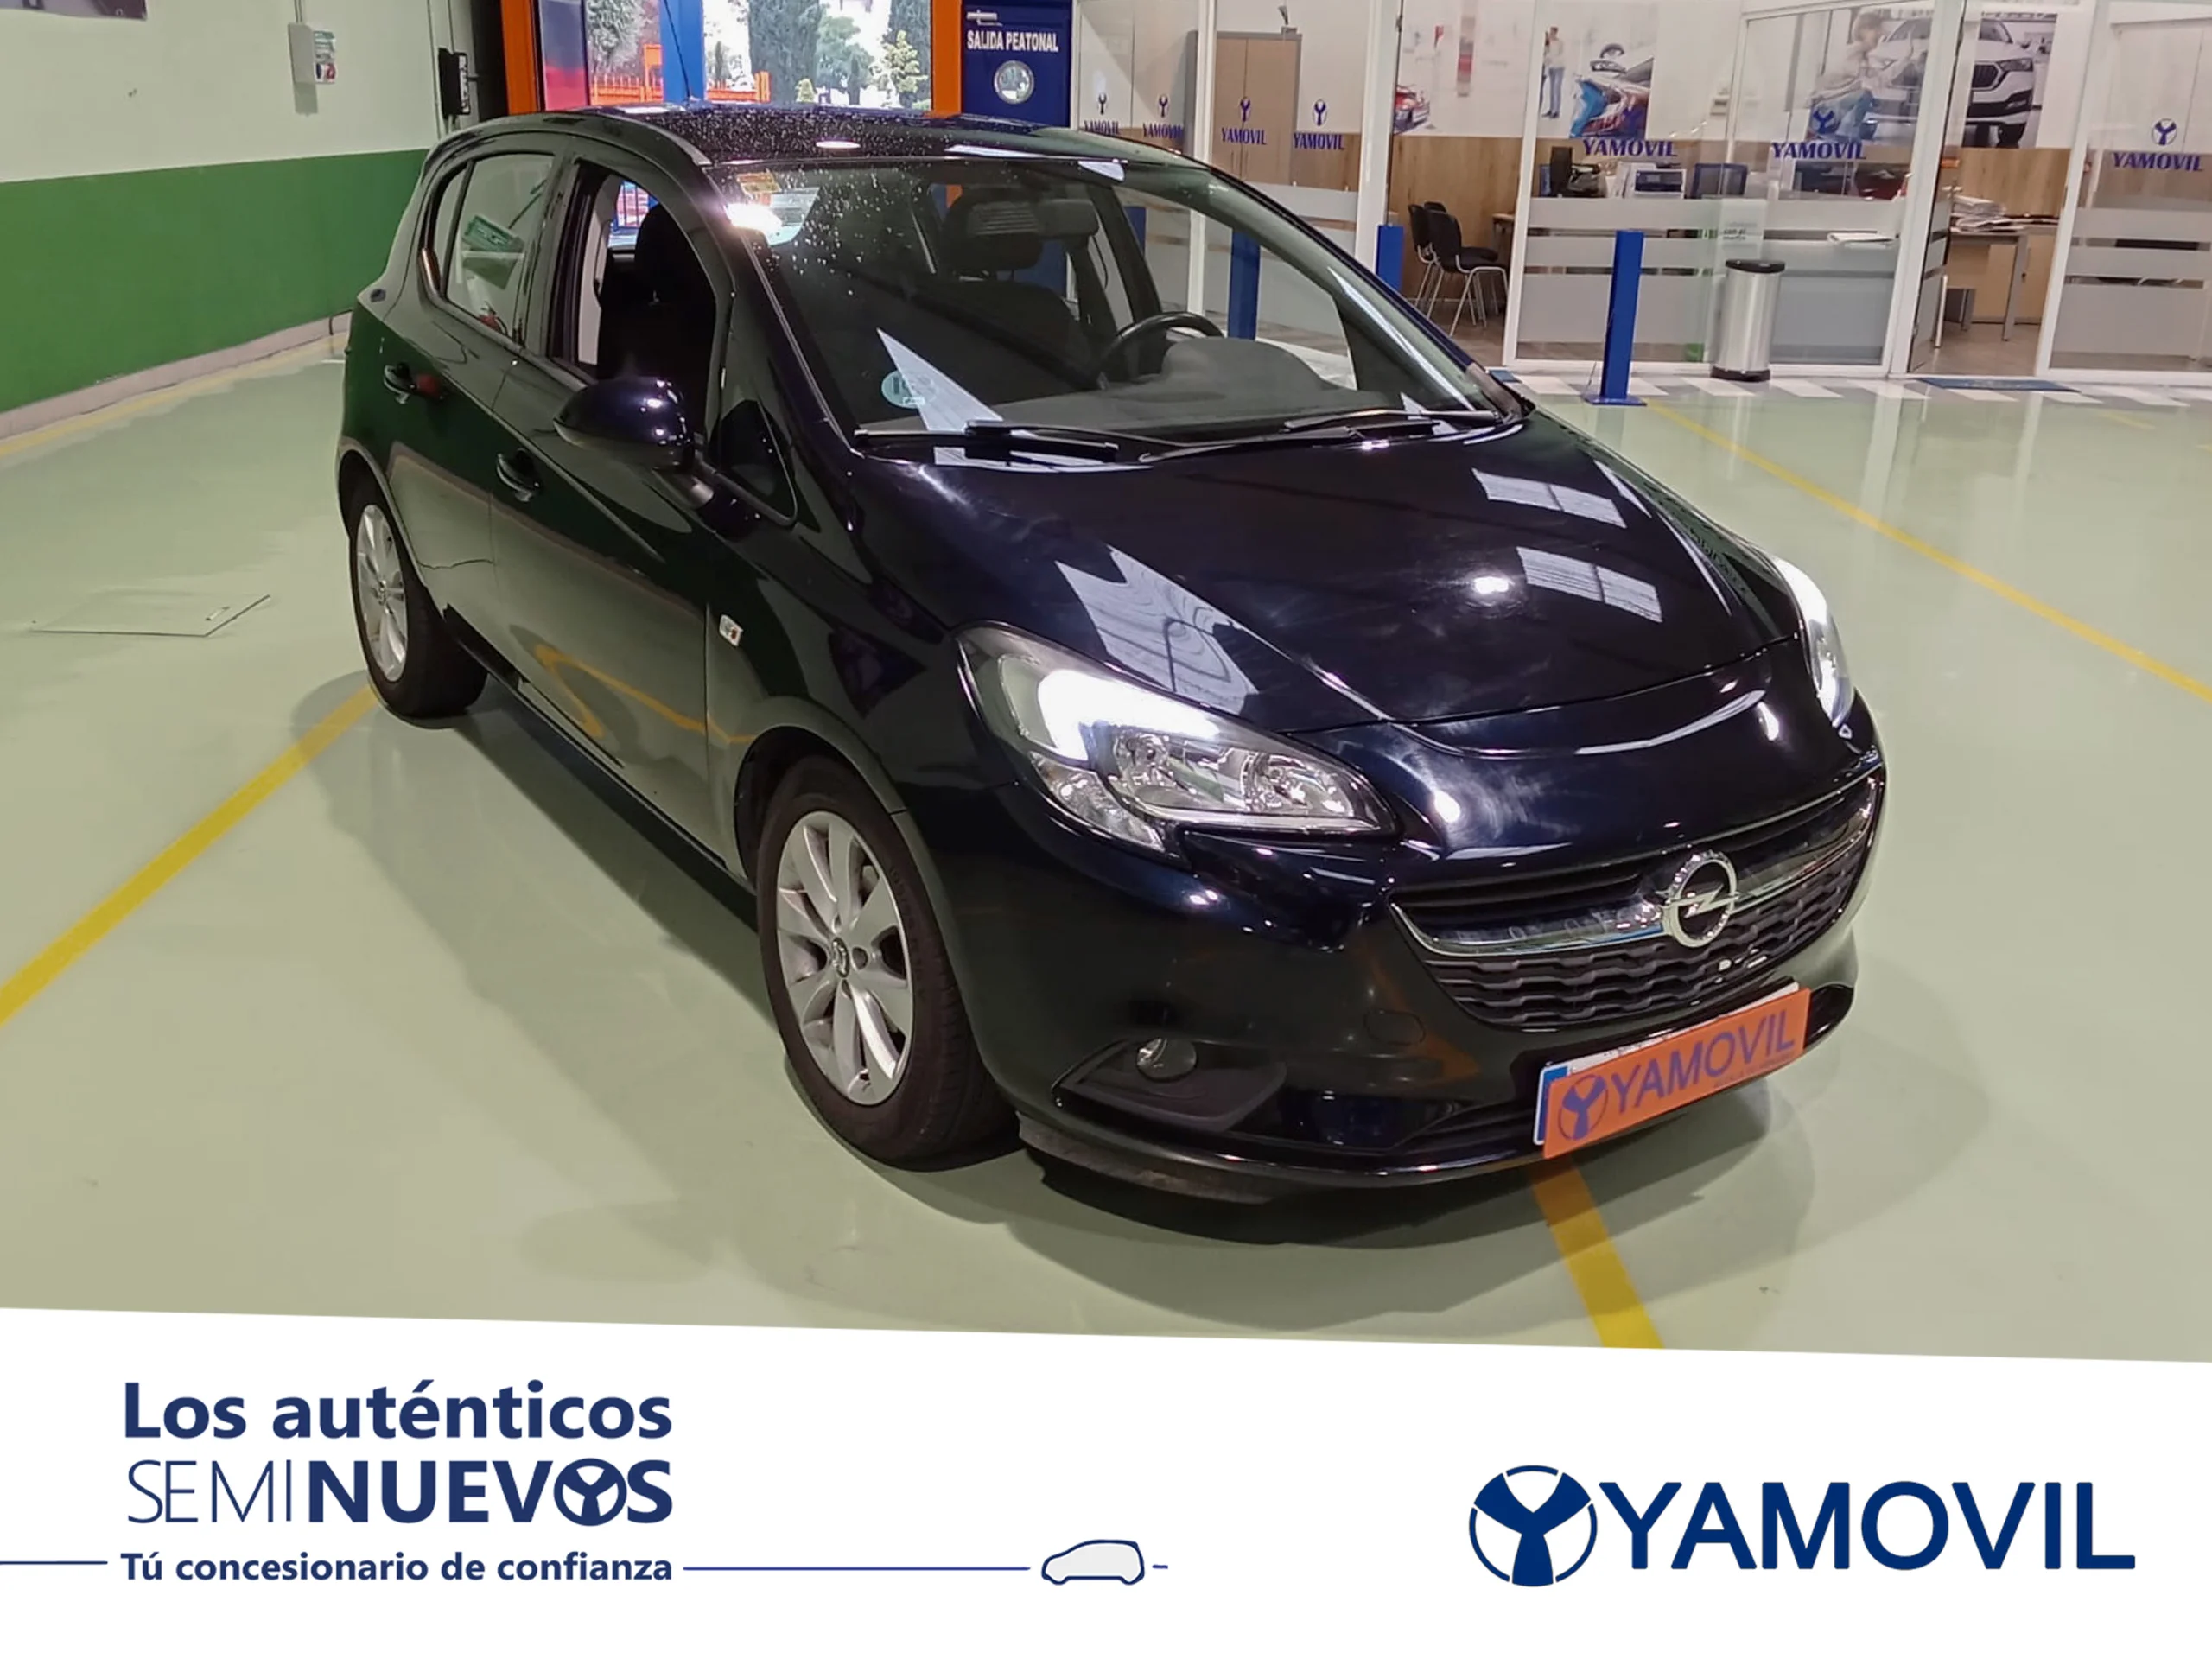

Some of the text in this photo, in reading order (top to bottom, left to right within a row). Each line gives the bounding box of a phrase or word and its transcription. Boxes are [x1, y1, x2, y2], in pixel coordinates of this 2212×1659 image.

[967, 30, 1058, 52] SALIDA PEATONAL
[1222, 128, 1267, 145] YAMOVIL
[1294, 133, 1345, 150] YAMOVIL
[1583, 138, 1678, 156] YAMOVIL
[1771, 142, 1866, 160] YAMOVIL
[2113, 152, 2204, 171] YAMOVIL
[1611, 1010, 1795, 1114] YAMOVIL
